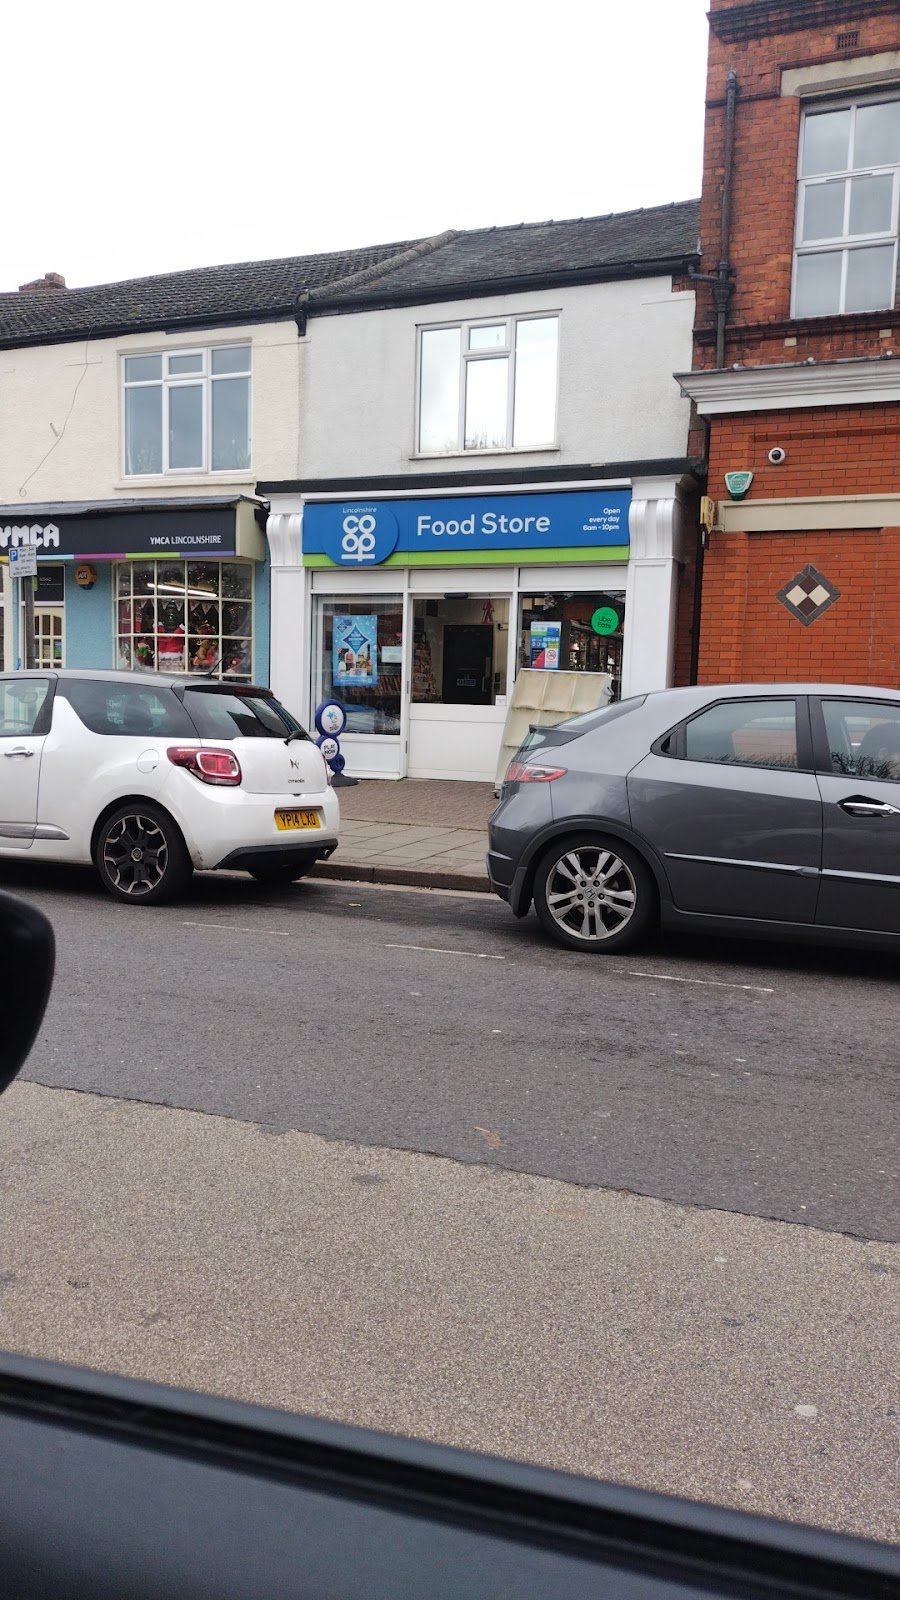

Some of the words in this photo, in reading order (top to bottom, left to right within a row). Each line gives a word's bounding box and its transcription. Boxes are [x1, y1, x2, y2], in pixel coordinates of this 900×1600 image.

[603, 507, 621, 516] Open
[607, 515, 620, 523] day
[417, 513, 475, 536] Food
[481, 512, 551, 534] Store
[602, 523, 620, 531] 10pm
[0, 523, 60, 548] YMCA
[150, 536, 170, 545] YMCA
[170, 535, 222, 545] LINCOLNSHIRE
[11, 550, 18, 561] P
[598, 615, 613, 624] Uber
[597, 621, 612, 629] Eats
[279, 813, 300, 828] YP14
